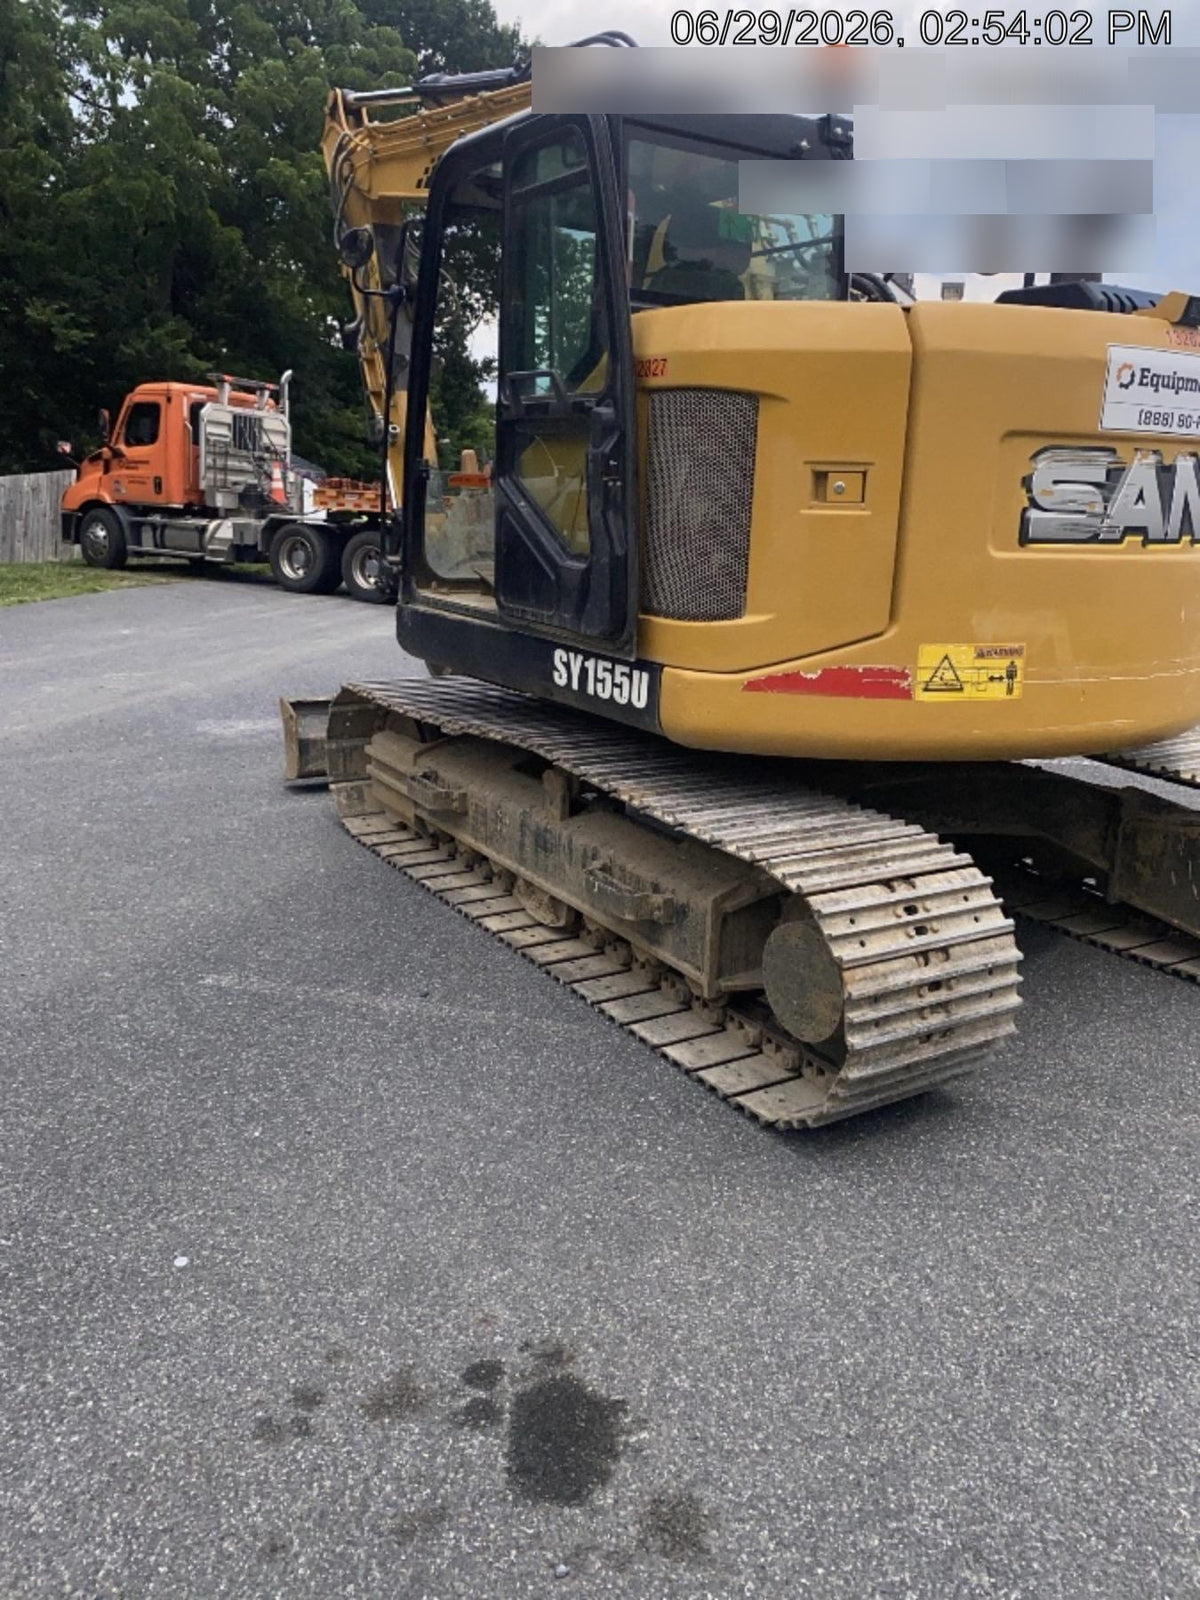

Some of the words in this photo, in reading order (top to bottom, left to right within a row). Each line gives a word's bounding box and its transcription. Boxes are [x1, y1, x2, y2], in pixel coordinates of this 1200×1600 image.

[1138, 368, 1200, 395] Equipm
[1138, 408, 1174, 428] (888)
[553, 648, 649, 709] SY155U
